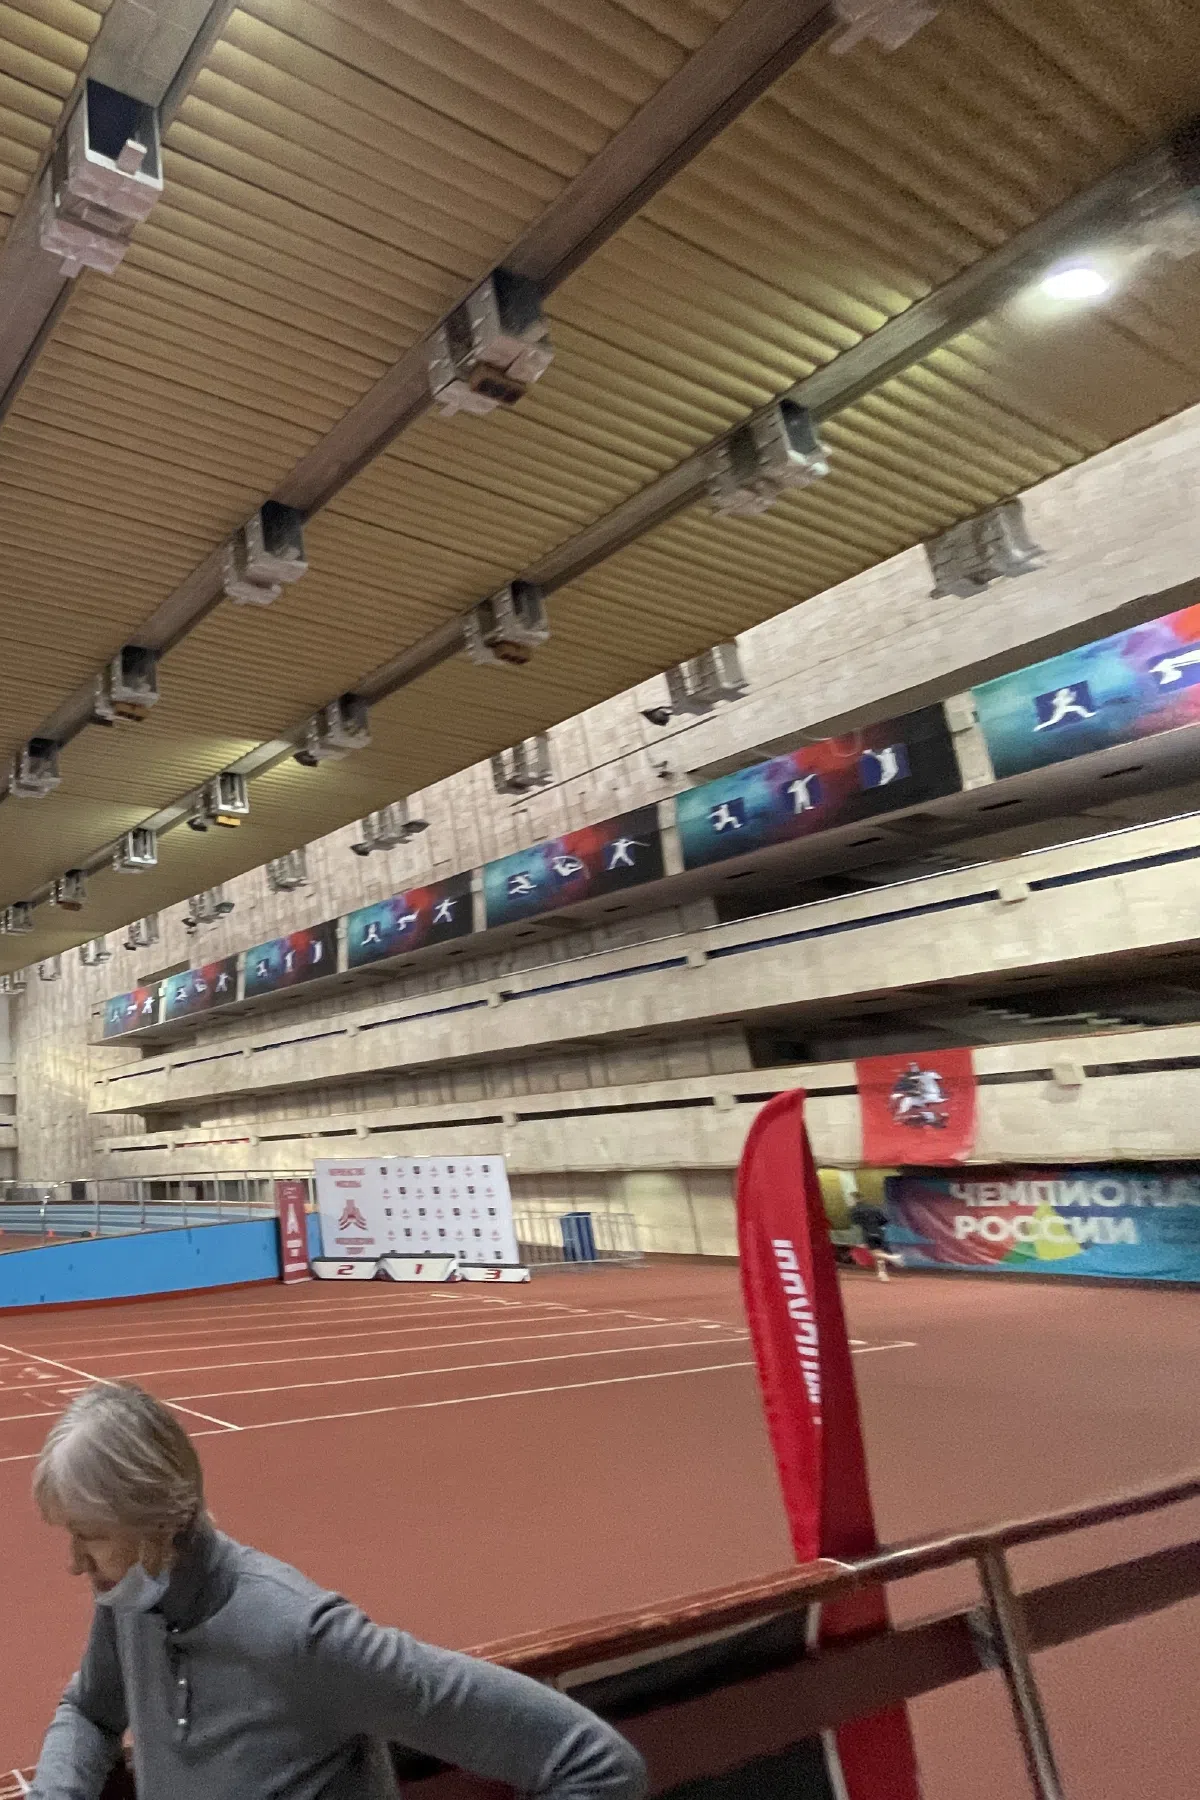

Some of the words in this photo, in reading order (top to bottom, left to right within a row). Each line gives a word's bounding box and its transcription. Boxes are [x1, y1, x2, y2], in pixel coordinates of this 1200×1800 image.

[954, 1215, 1138, 1245] РОССИИ
[336, 1264, 355, 1276] 2
[414, 1263, 423, 1275] 1
[484, 1268, 503, 1280] 3
